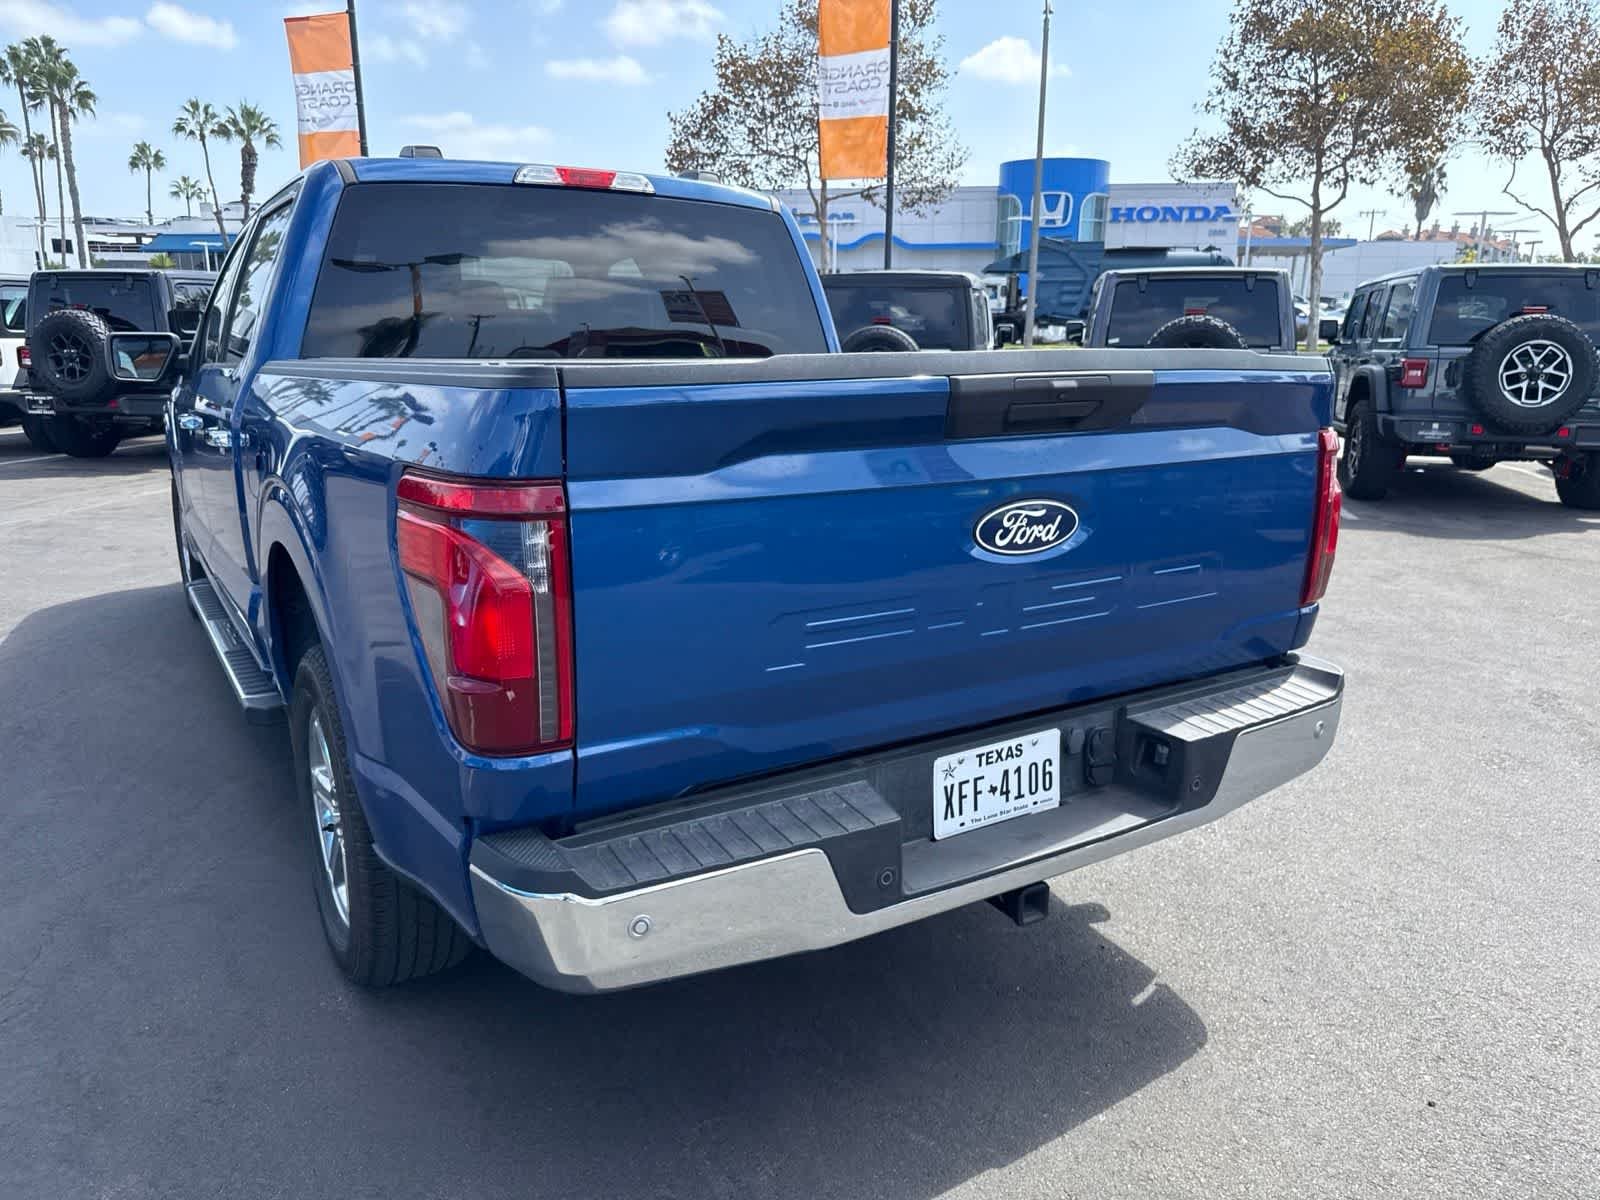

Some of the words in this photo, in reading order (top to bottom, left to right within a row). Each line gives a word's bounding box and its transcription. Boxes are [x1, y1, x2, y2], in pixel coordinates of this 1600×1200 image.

[1109, 205, 1237, 223] HONDA
[995, 508, 1063, 547] Ford
[976, 743, 1023, 768] TEXAS
[971, 817, 982, 825] The
[983, 813, 998, 821] Lone
[1000, 808, 1012, 816] Star
[1013, 804, 1029, 812] State
